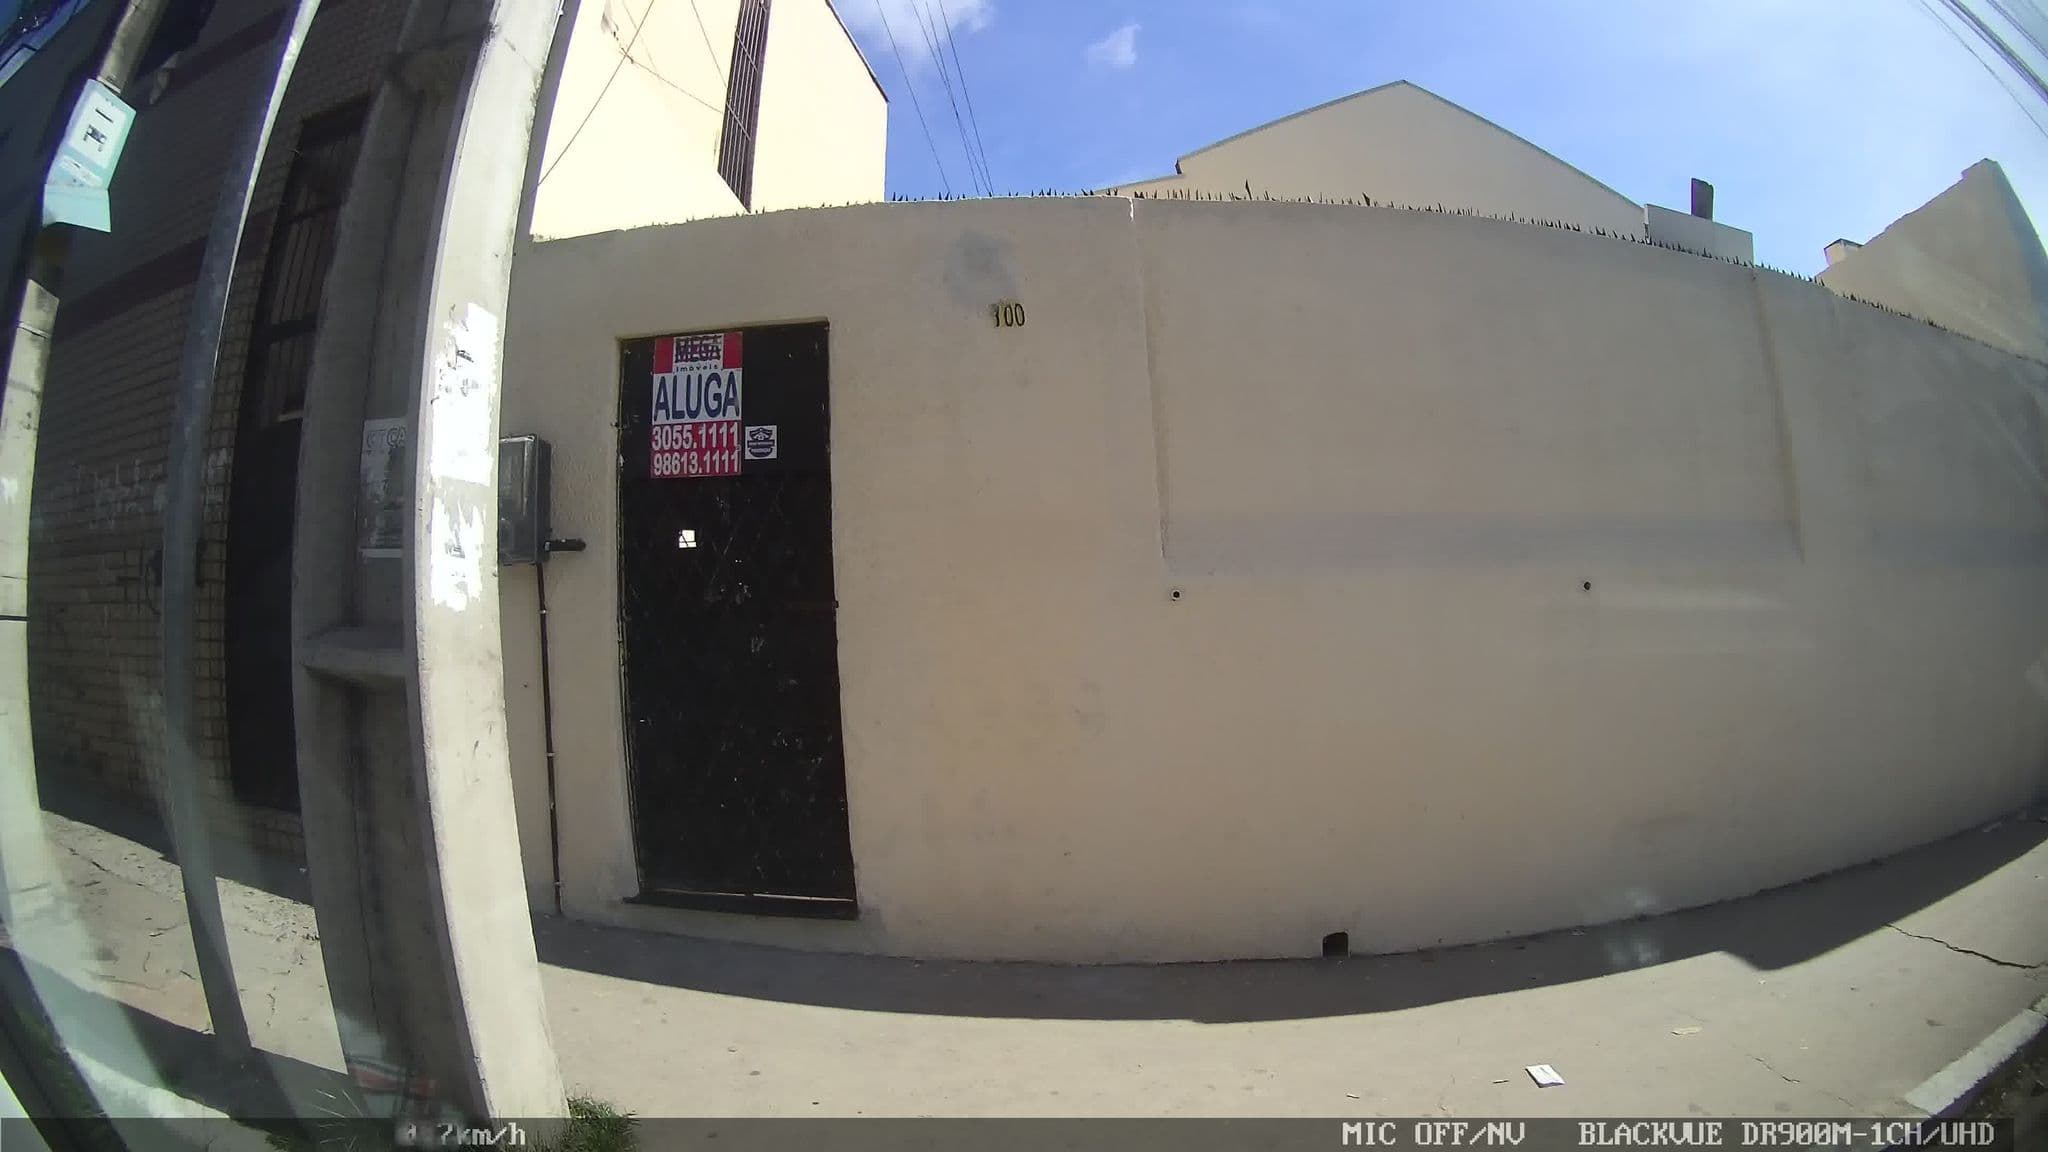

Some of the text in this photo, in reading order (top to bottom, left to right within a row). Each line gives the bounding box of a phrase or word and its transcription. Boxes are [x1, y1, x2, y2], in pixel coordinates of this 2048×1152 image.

[993, 303, 1025, 327] 100
[654, 371, 739, 421] ALUGA
[652, 422, 738, 451] 3055.1111
[653, 450, 738, 475] 98613.1111
